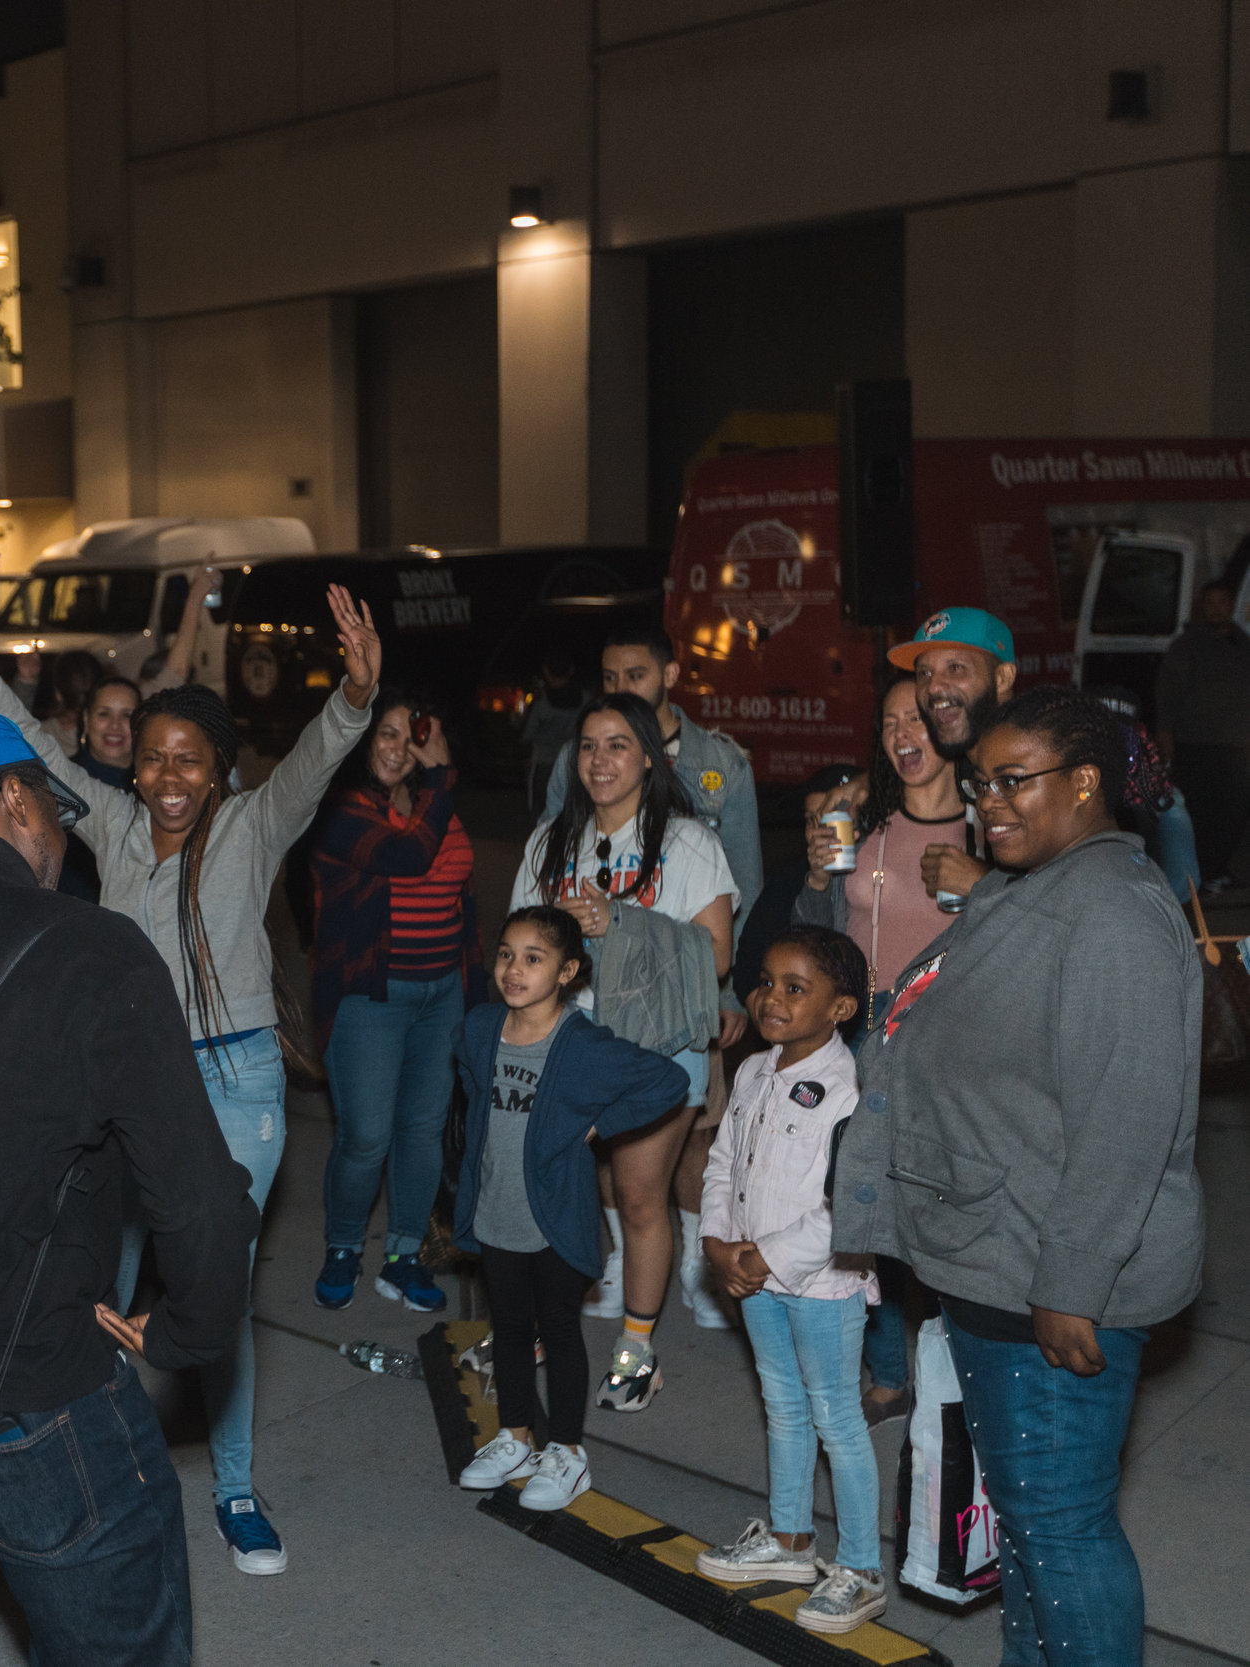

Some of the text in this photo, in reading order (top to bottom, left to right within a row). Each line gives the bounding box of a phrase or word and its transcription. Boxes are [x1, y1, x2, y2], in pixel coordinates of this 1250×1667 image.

[990, 451, 1079, 489] Quarter
[1081, 450, 1144, 481] Sawn
[1145, 449, 1240, 480] Millwork
[392, 597, 472, 627] BREWERY
[503, 1064, 538, 1087] WIT
